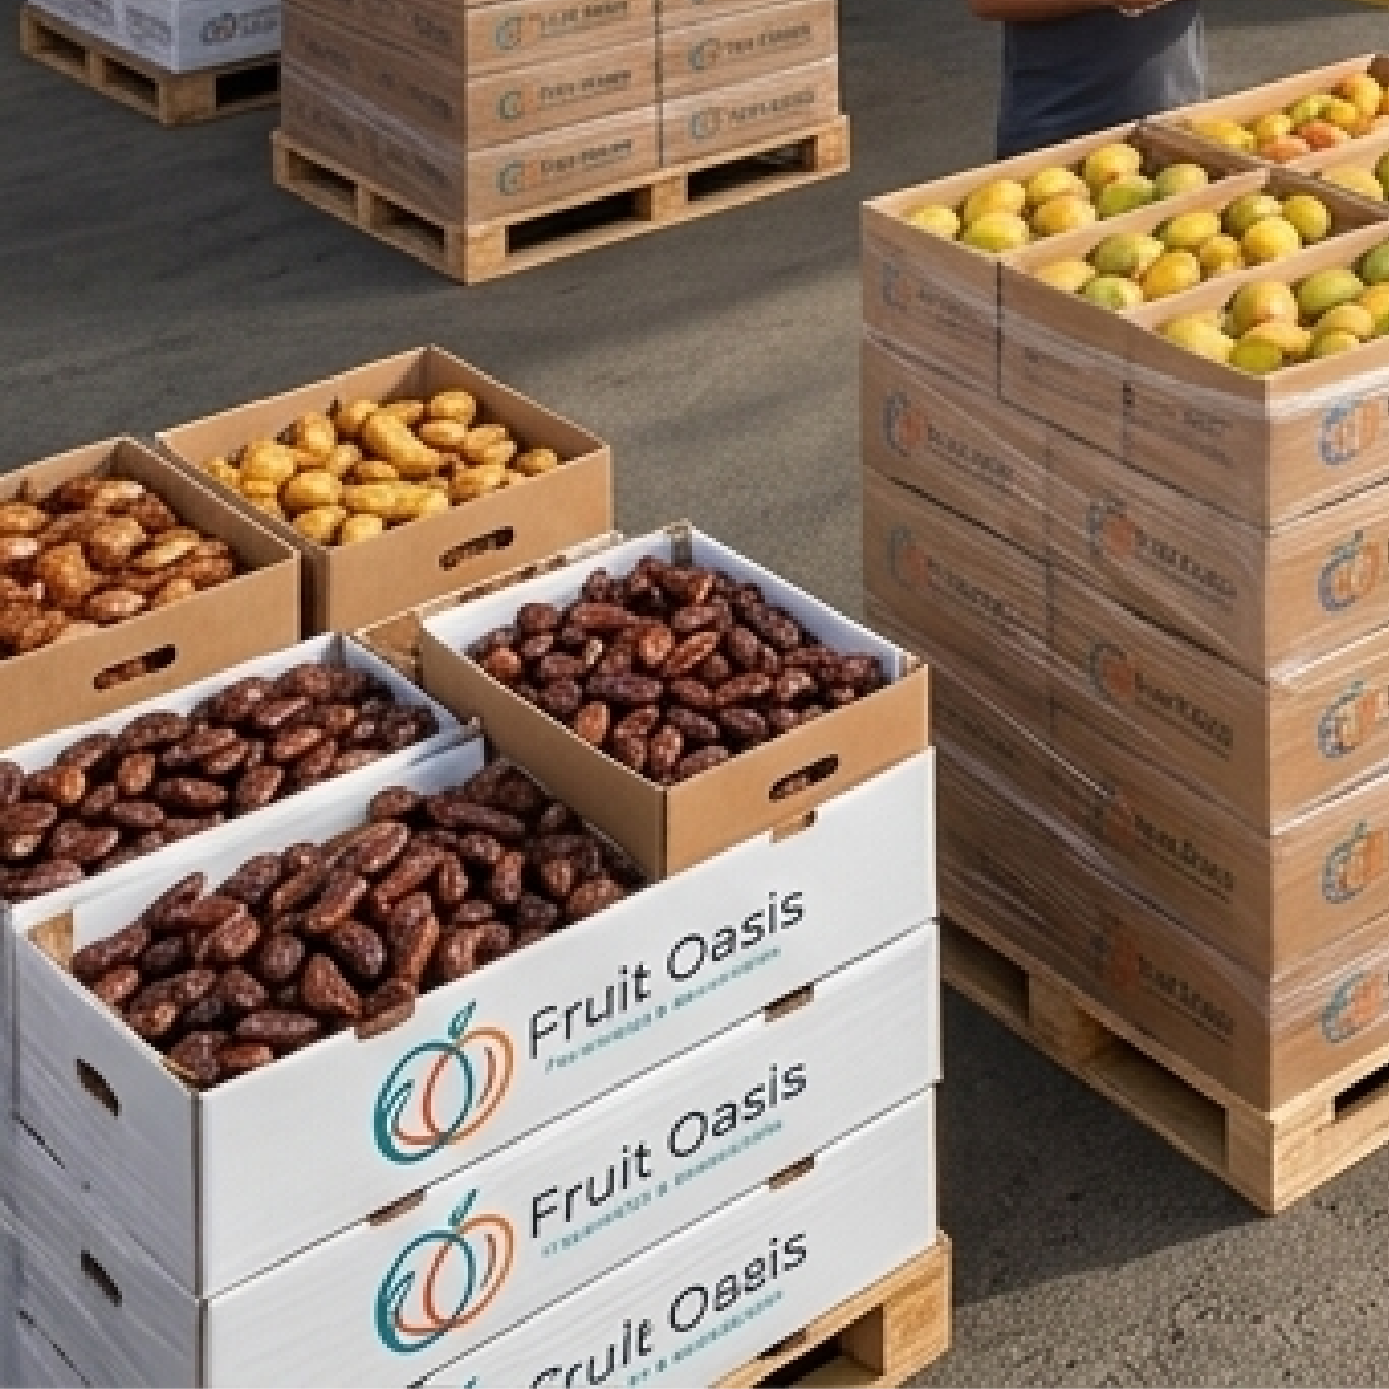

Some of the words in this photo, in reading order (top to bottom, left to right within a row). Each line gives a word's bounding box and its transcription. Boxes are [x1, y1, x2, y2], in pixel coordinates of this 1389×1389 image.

[530, 963, 650, 1060] Fruit
[667, 891, 804, 981] Oasis
[531, 1143, 651, 1239] Fruit
[668, 1063, 807, 1158] Oasis
